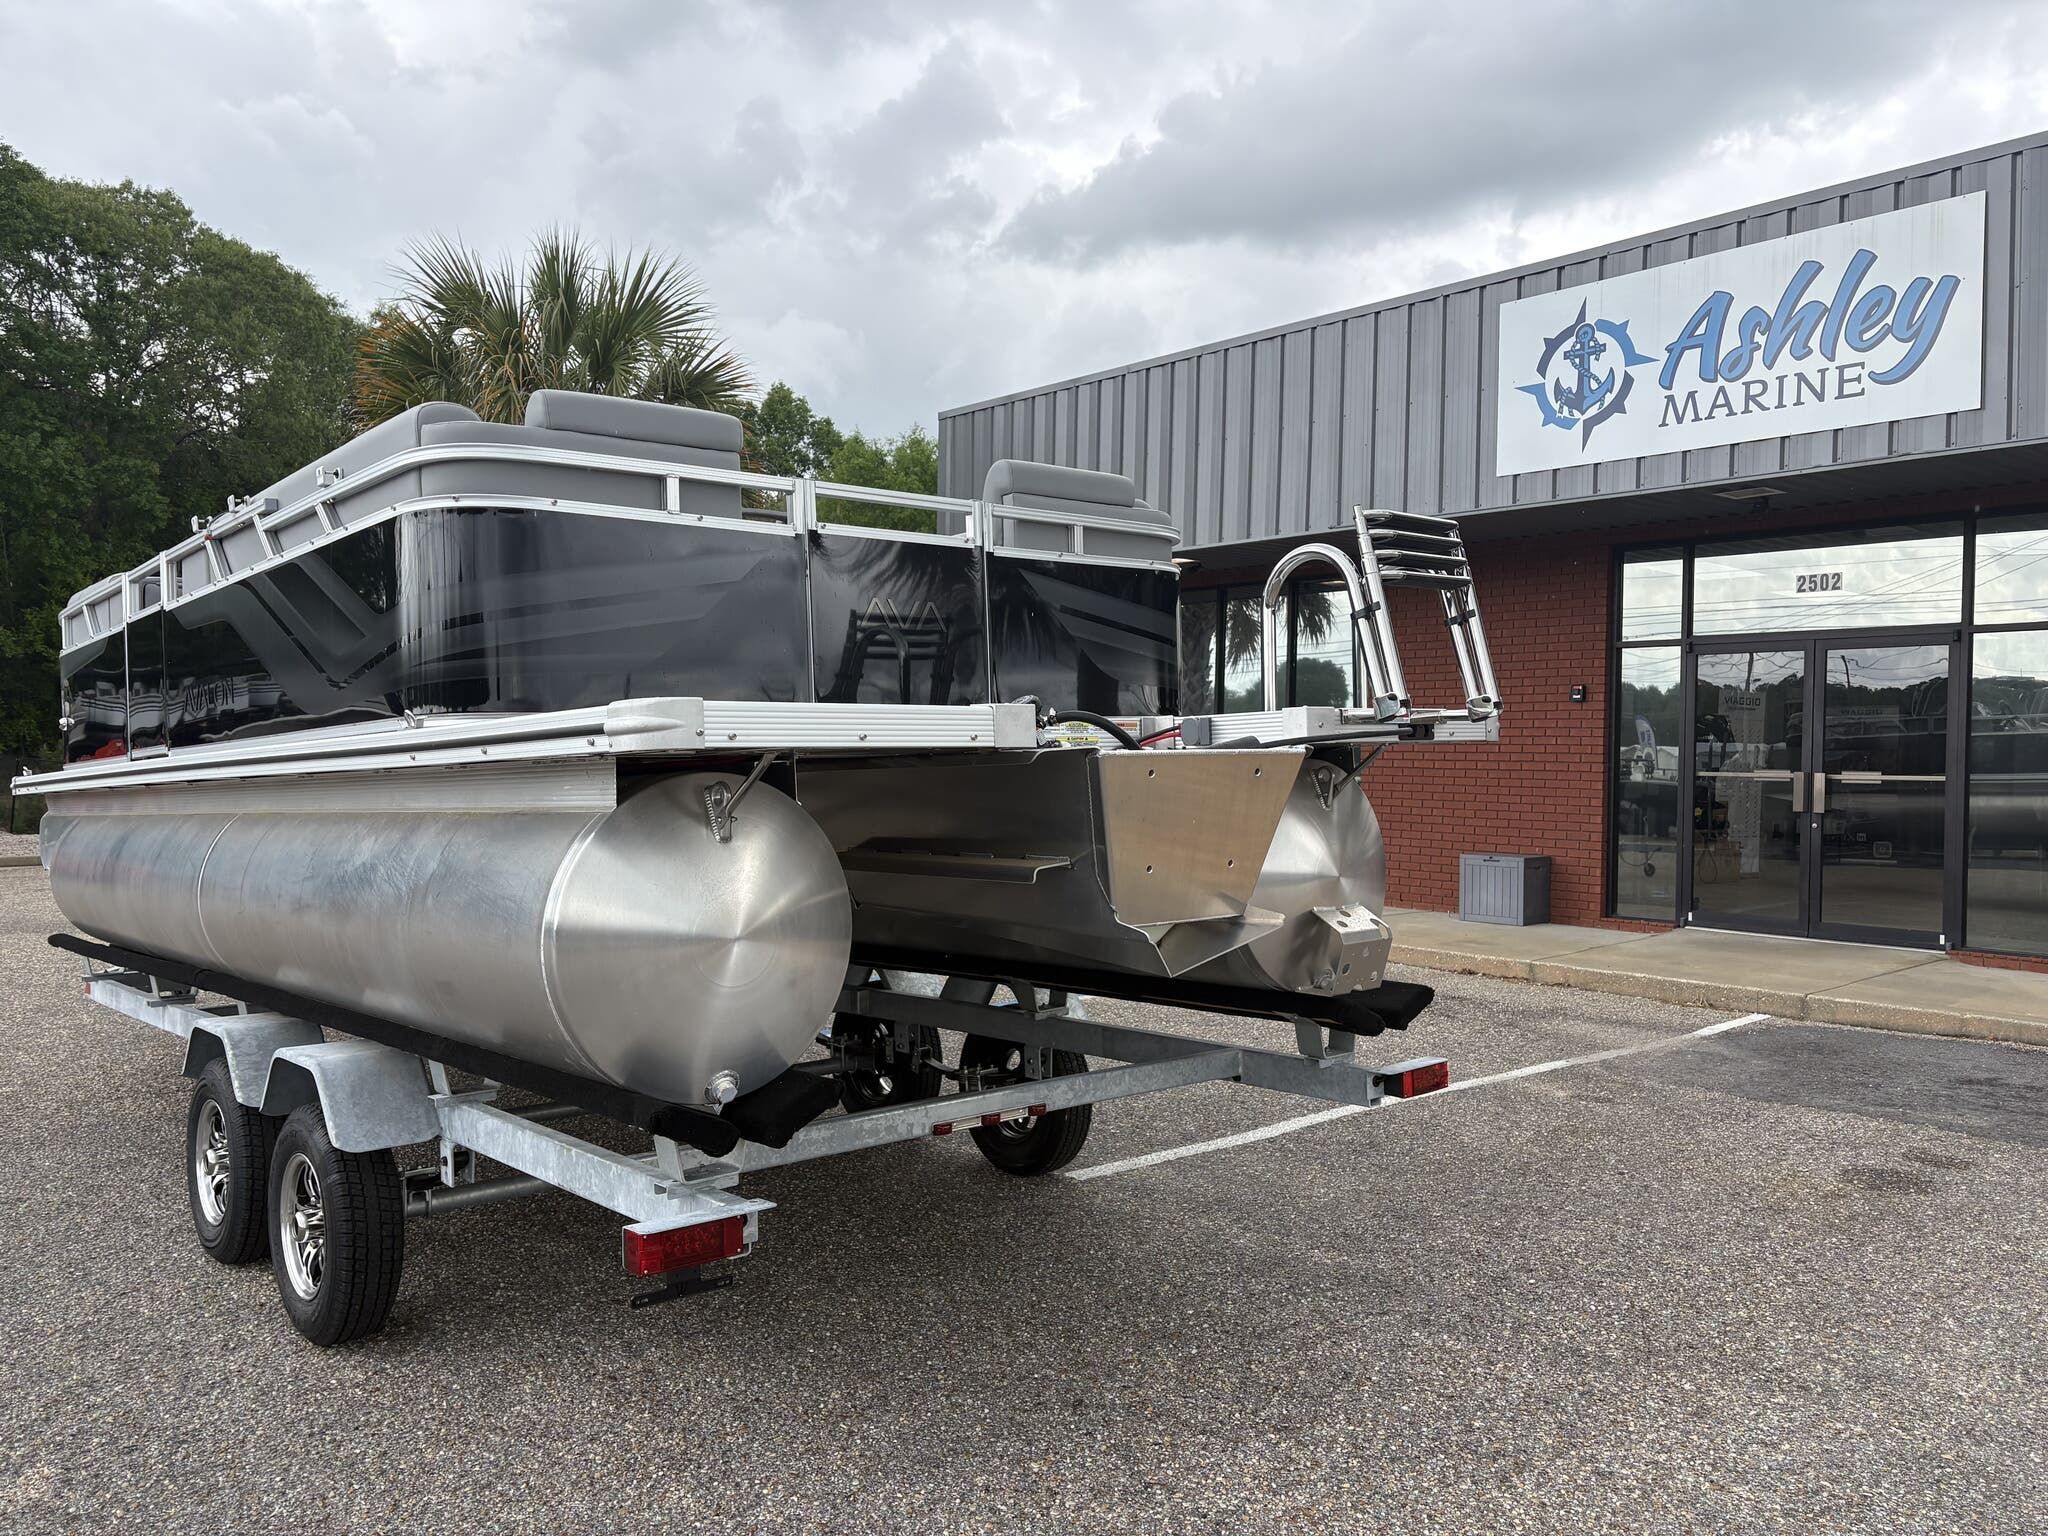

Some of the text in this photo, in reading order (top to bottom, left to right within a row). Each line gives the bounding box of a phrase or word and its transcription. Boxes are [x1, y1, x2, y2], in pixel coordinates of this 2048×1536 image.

[1659, 249, 1961, 390] Ashley
[1658, 362, 1866, 427] MARINE
[1797, 573, 1841, 593] 2502
[861, 598, 947, 632] AVA
[184, 678, 235, 712] AVALON
